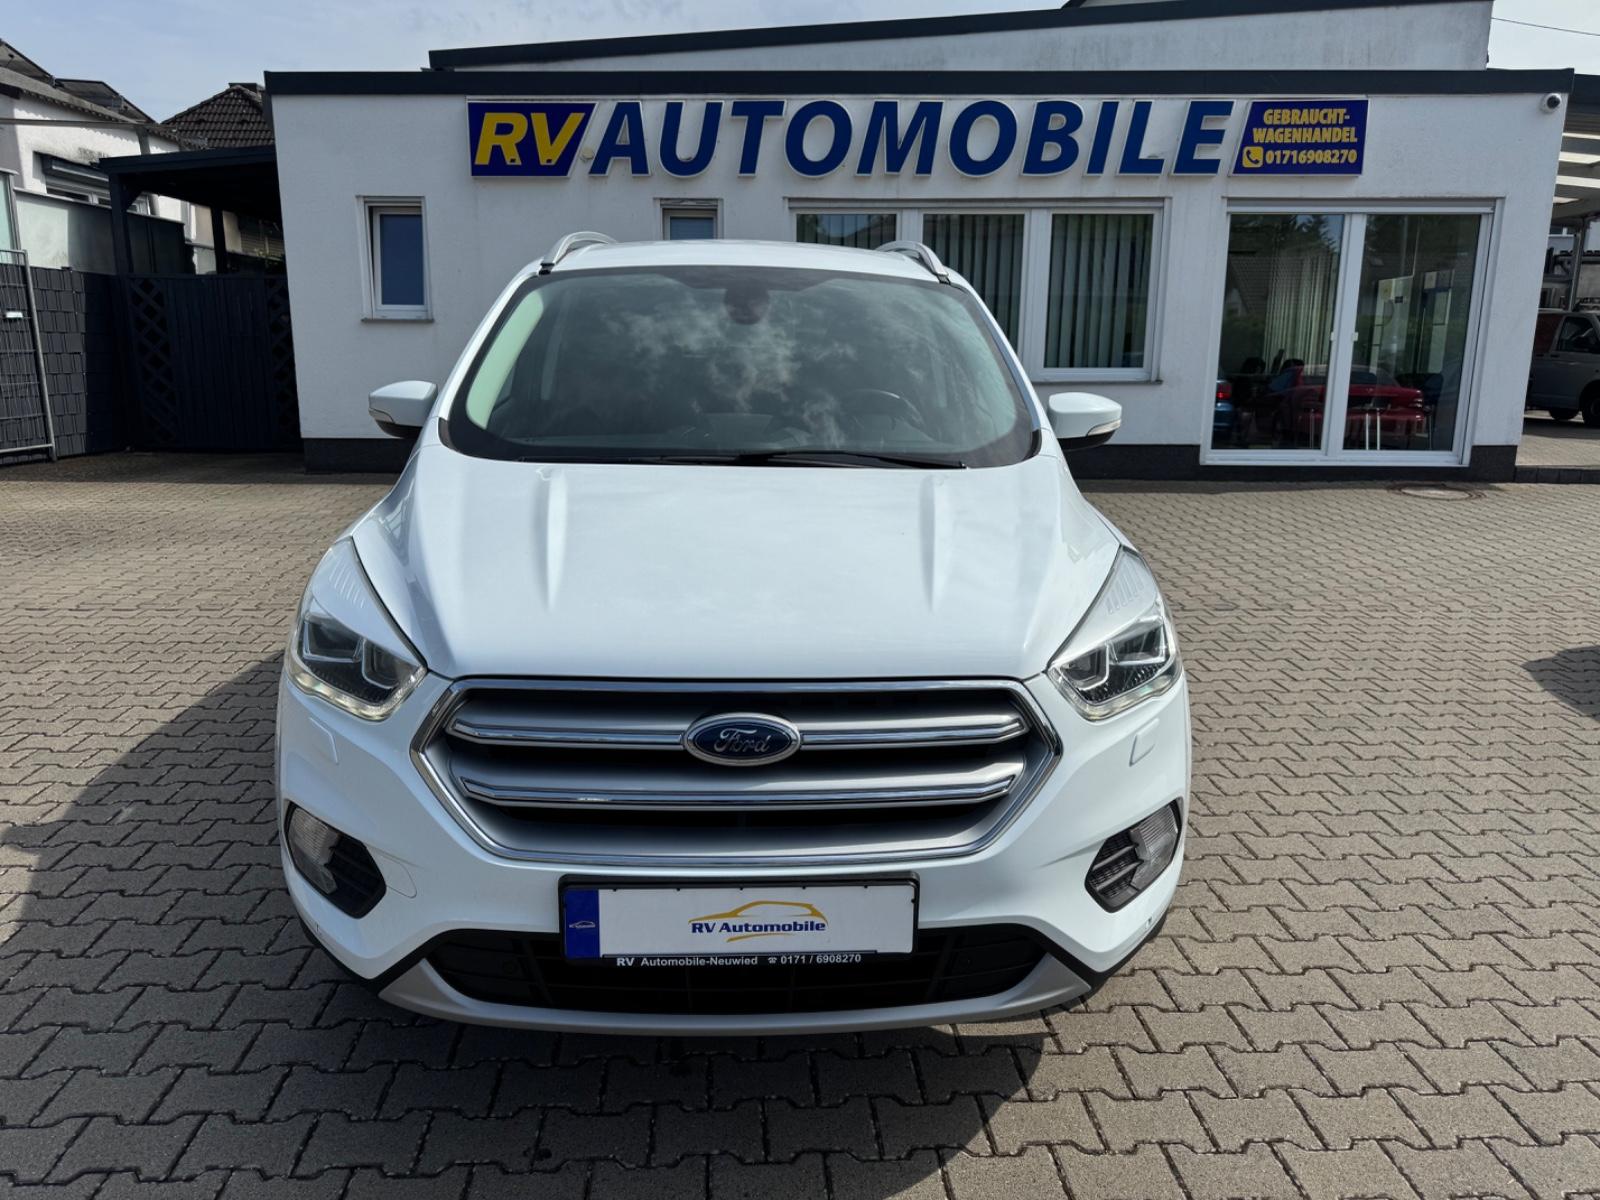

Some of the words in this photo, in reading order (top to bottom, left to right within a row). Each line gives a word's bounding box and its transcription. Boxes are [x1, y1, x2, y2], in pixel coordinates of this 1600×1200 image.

[1263, 108, 1350, 125] GEBRAUCHT-
[588, 100, 1235, 176] AUTOMOBILE
[1252, 127, 1358, 143] WAGENHANDEL
[1265, 149, 1358, 164] 01716908270
[713, 727, 771, 752] Ford
[691, 922, 716, 933] RV
[718, 921, 826, 933] Automobile
[616, 957, 635, 967] RV
[640, 956, 758, 967] Automobile-Neuwied
[780, 955, 806, 964] 0171
[816, 954, 861, 964] 6908270
